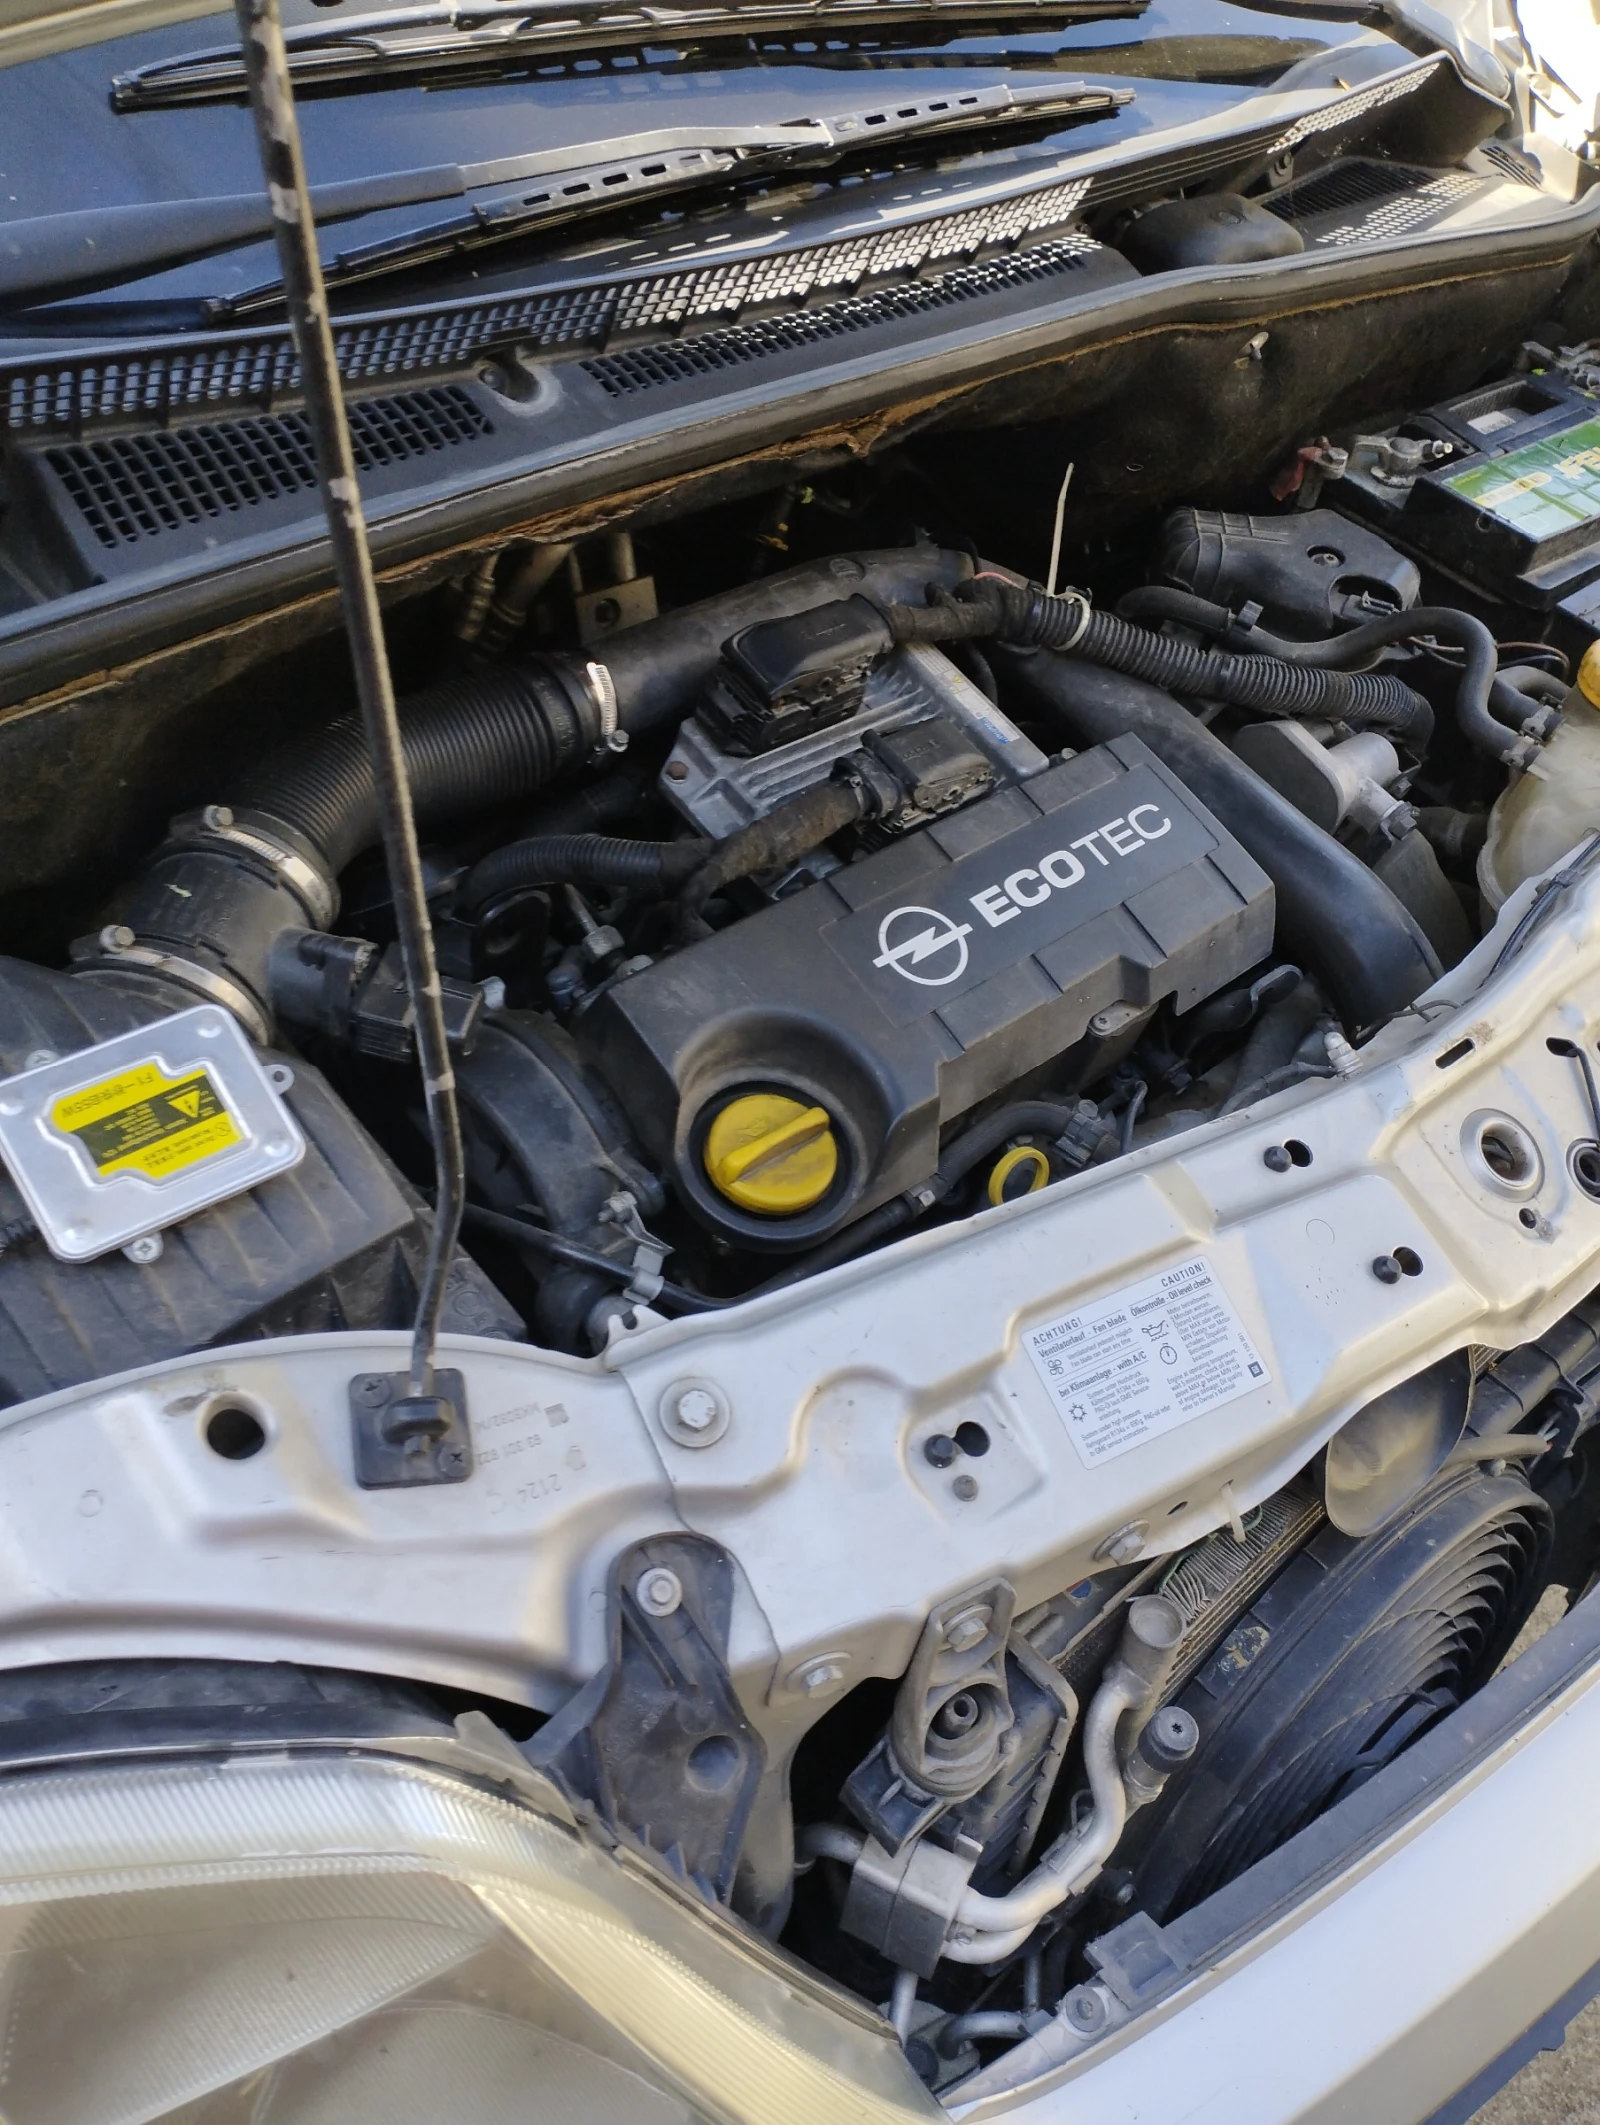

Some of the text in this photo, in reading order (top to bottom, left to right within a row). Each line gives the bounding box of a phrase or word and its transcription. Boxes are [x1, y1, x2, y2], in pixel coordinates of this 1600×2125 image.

[970, 803, 1172, 928] ECOTEC
[1161, 1262, 1205, 1287] CAUTION!
[1168, 1289, 1179, 1299] Oil
[1176, 1283, 1193, 1295] level
[1193, 1275, 1212, 1289] check
[1033, 1317, 1082, 1345] ACHTUNG!
[1038, 1331, 1085, 1357] Ventilatorlauf
[1092, 1324, 1107, 1334] Fan
[1106, 1315, 1126, 1327] blade
[1058, 1388, 1070, 1397] bei
[1069, 1369, 1112, 1391] Klimaanlage
[1116, 1358, 1133, 1370] with
[1132, 1350, 1146, 1363] A/C
